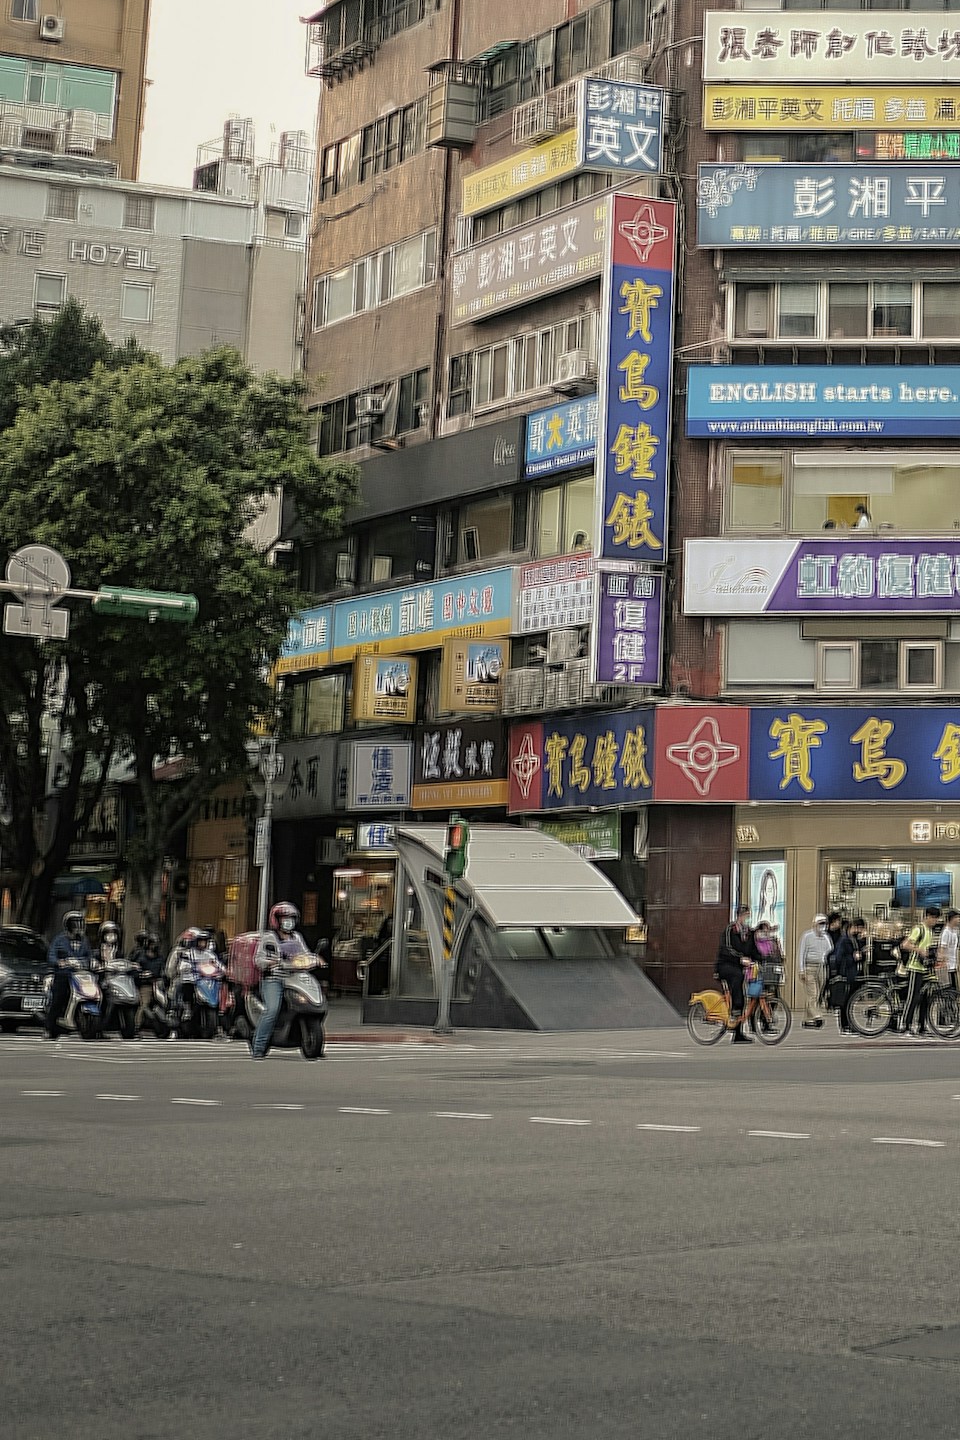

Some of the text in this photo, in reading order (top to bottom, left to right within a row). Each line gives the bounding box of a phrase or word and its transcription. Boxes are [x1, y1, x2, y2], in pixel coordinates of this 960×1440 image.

[587, 83, 662, 118] 彭湘平
[711, 97, 825, 122] 彭湘平英文
[585, 116, 660, 170] 英文
[708, 381, 960, 404] ENGLISH starts here.
[612, 599, 647, 663] 復健
[613, 662, 643, 682] 2F
